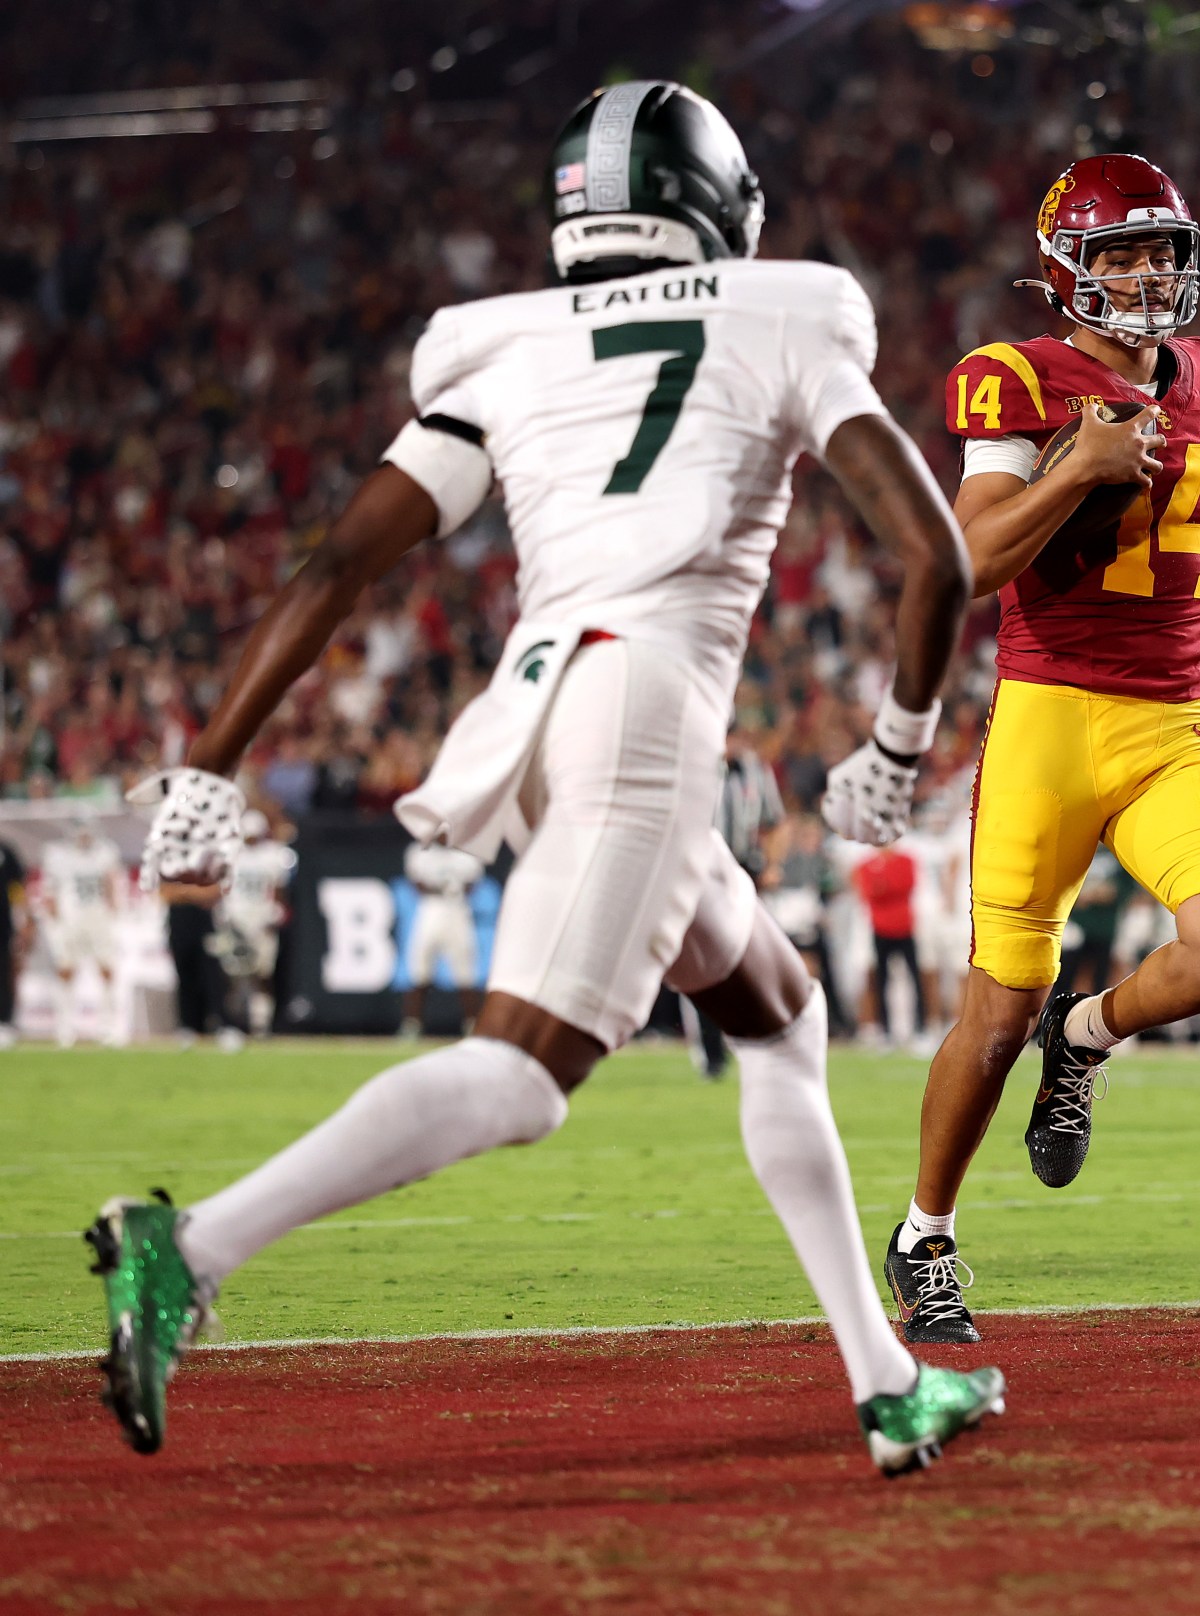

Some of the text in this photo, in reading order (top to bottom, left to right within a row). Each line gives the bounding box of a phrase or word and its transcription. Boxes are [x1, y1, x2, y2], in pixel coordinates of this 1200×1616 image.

[573, 274, 718, 313] EATON
[592, 319, 705, 494] 7
[957, 374, 1002, 429] 14
